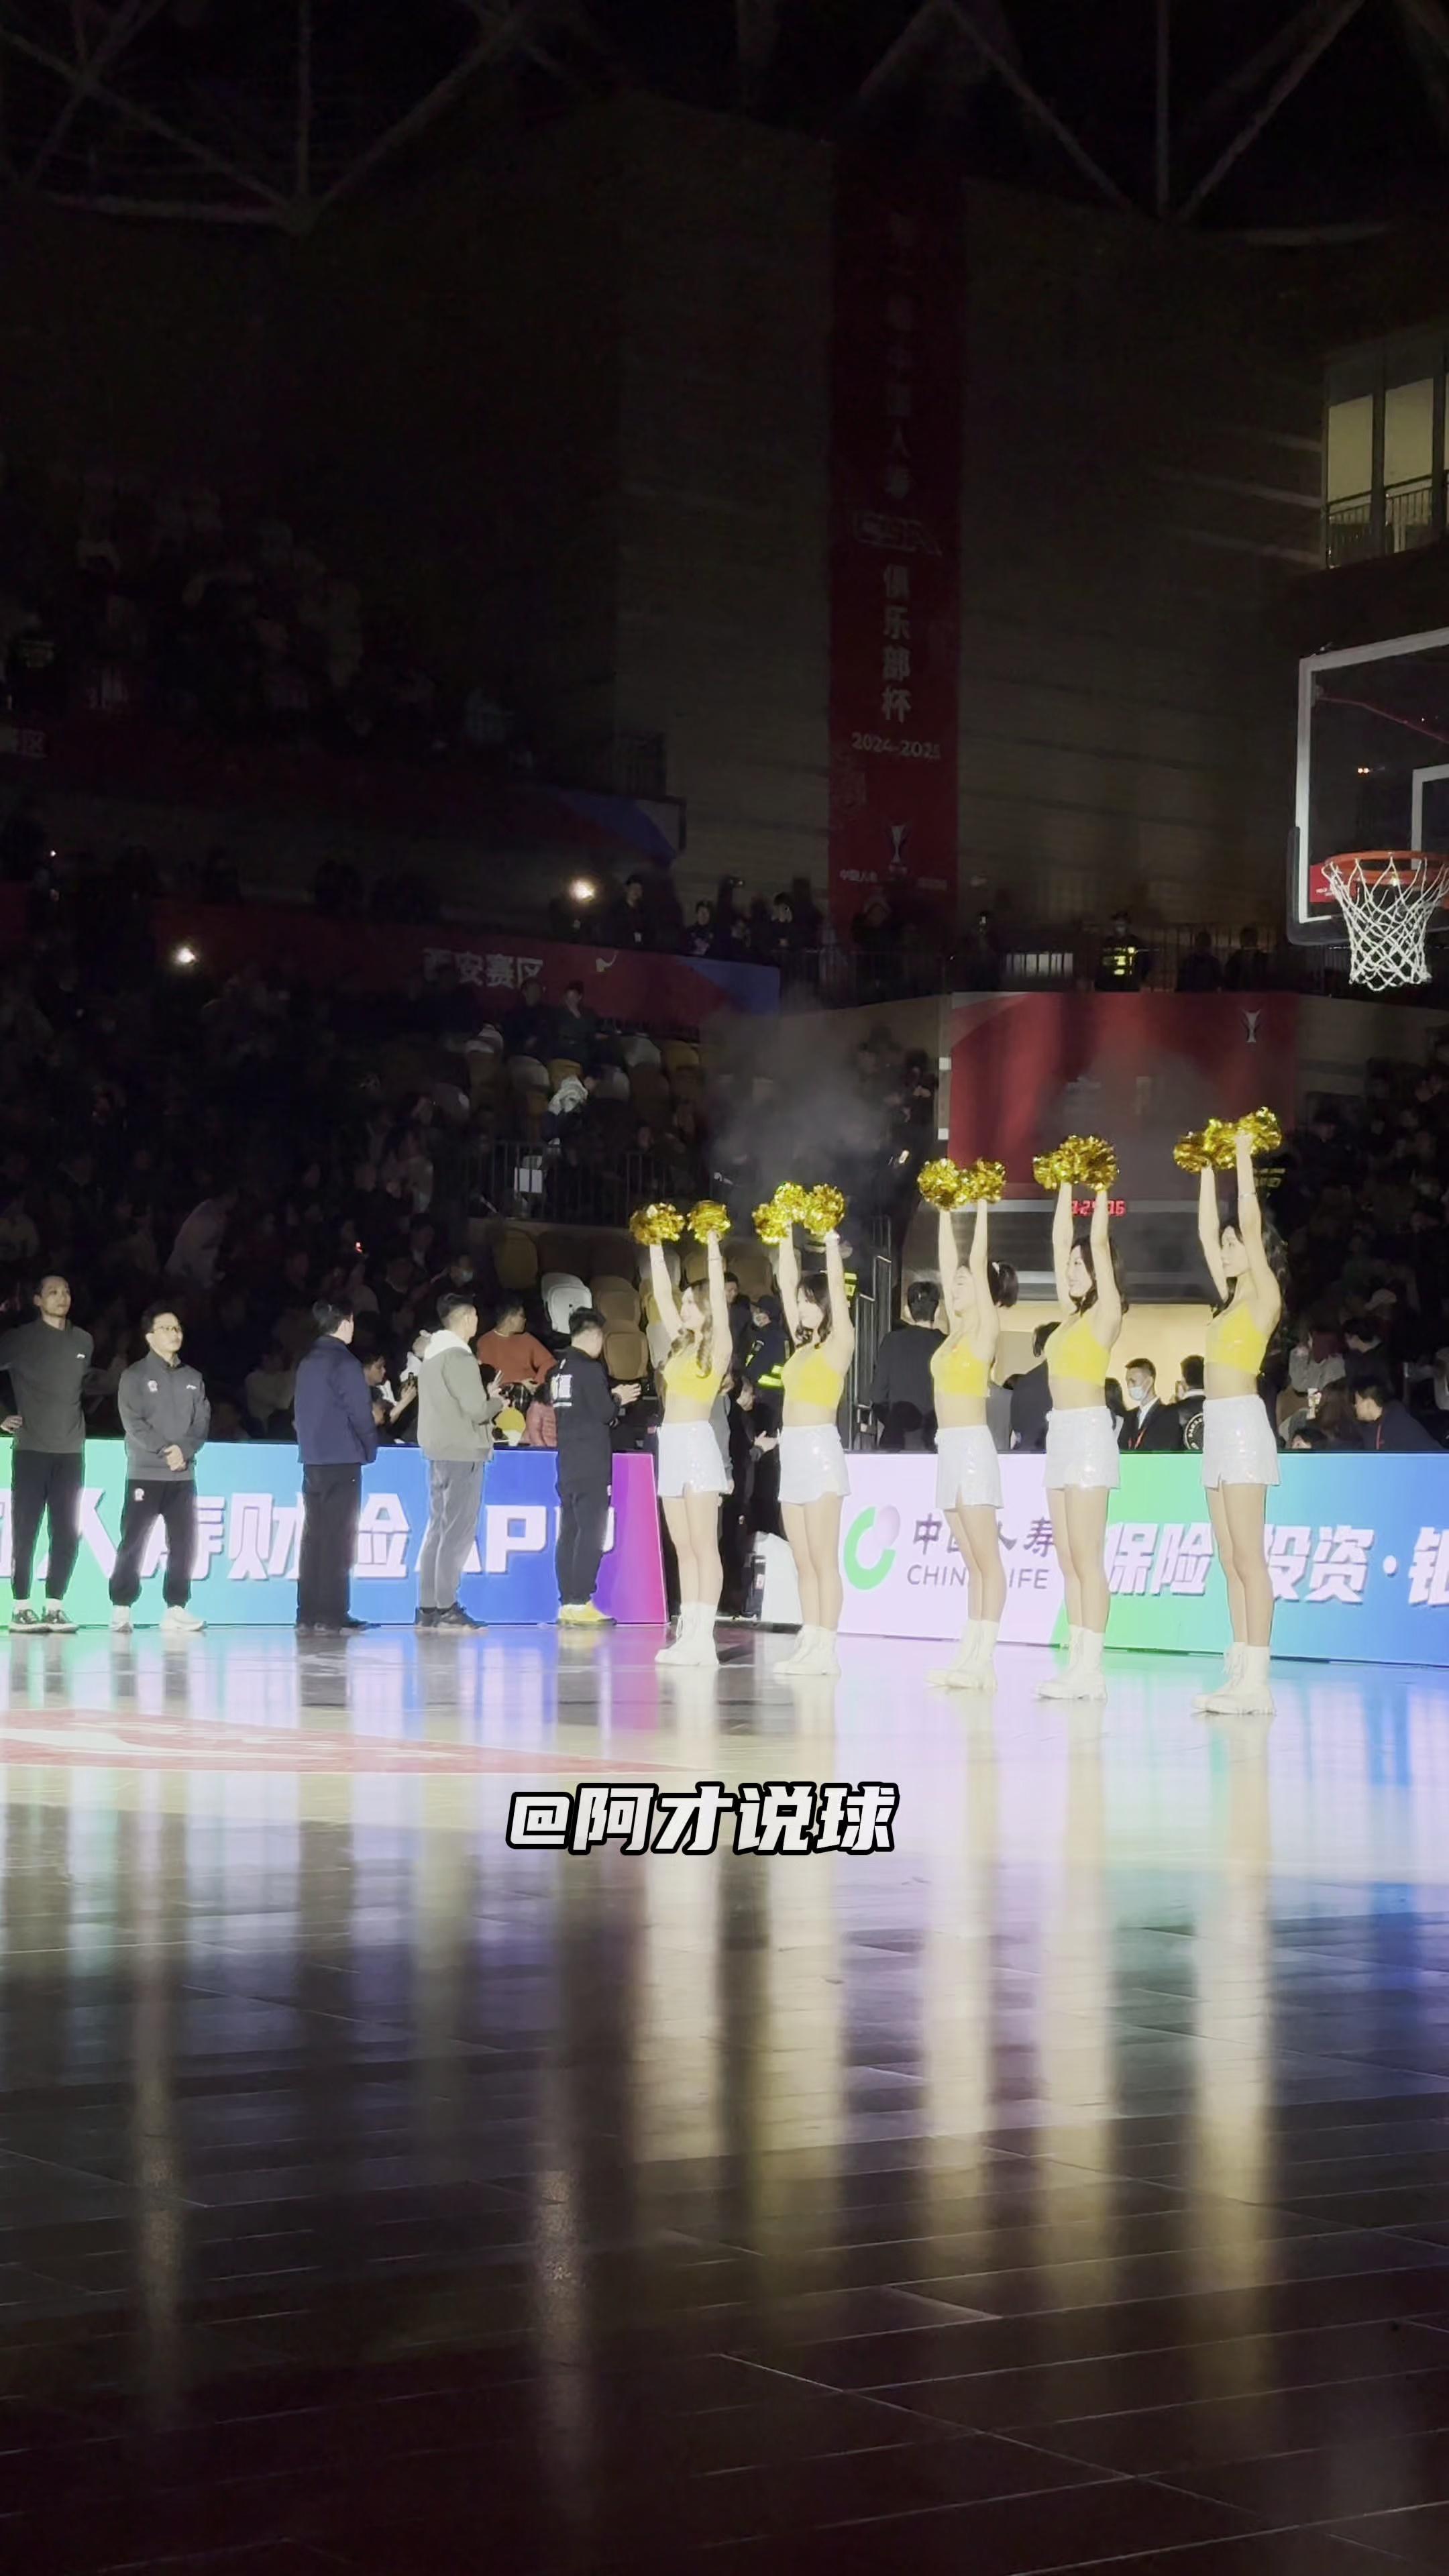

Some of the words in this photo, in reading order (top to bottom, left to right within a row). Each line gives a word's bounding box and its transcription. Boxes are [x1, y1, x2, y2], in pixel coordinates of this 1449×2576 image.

[882, 564, 912, 723] 俱乐部杯
[851, 731, 941, 760] 2024-2025
[907, 1564, 967, 1587] CHIN
[1008, 1568, 1050, 1589] IFE
